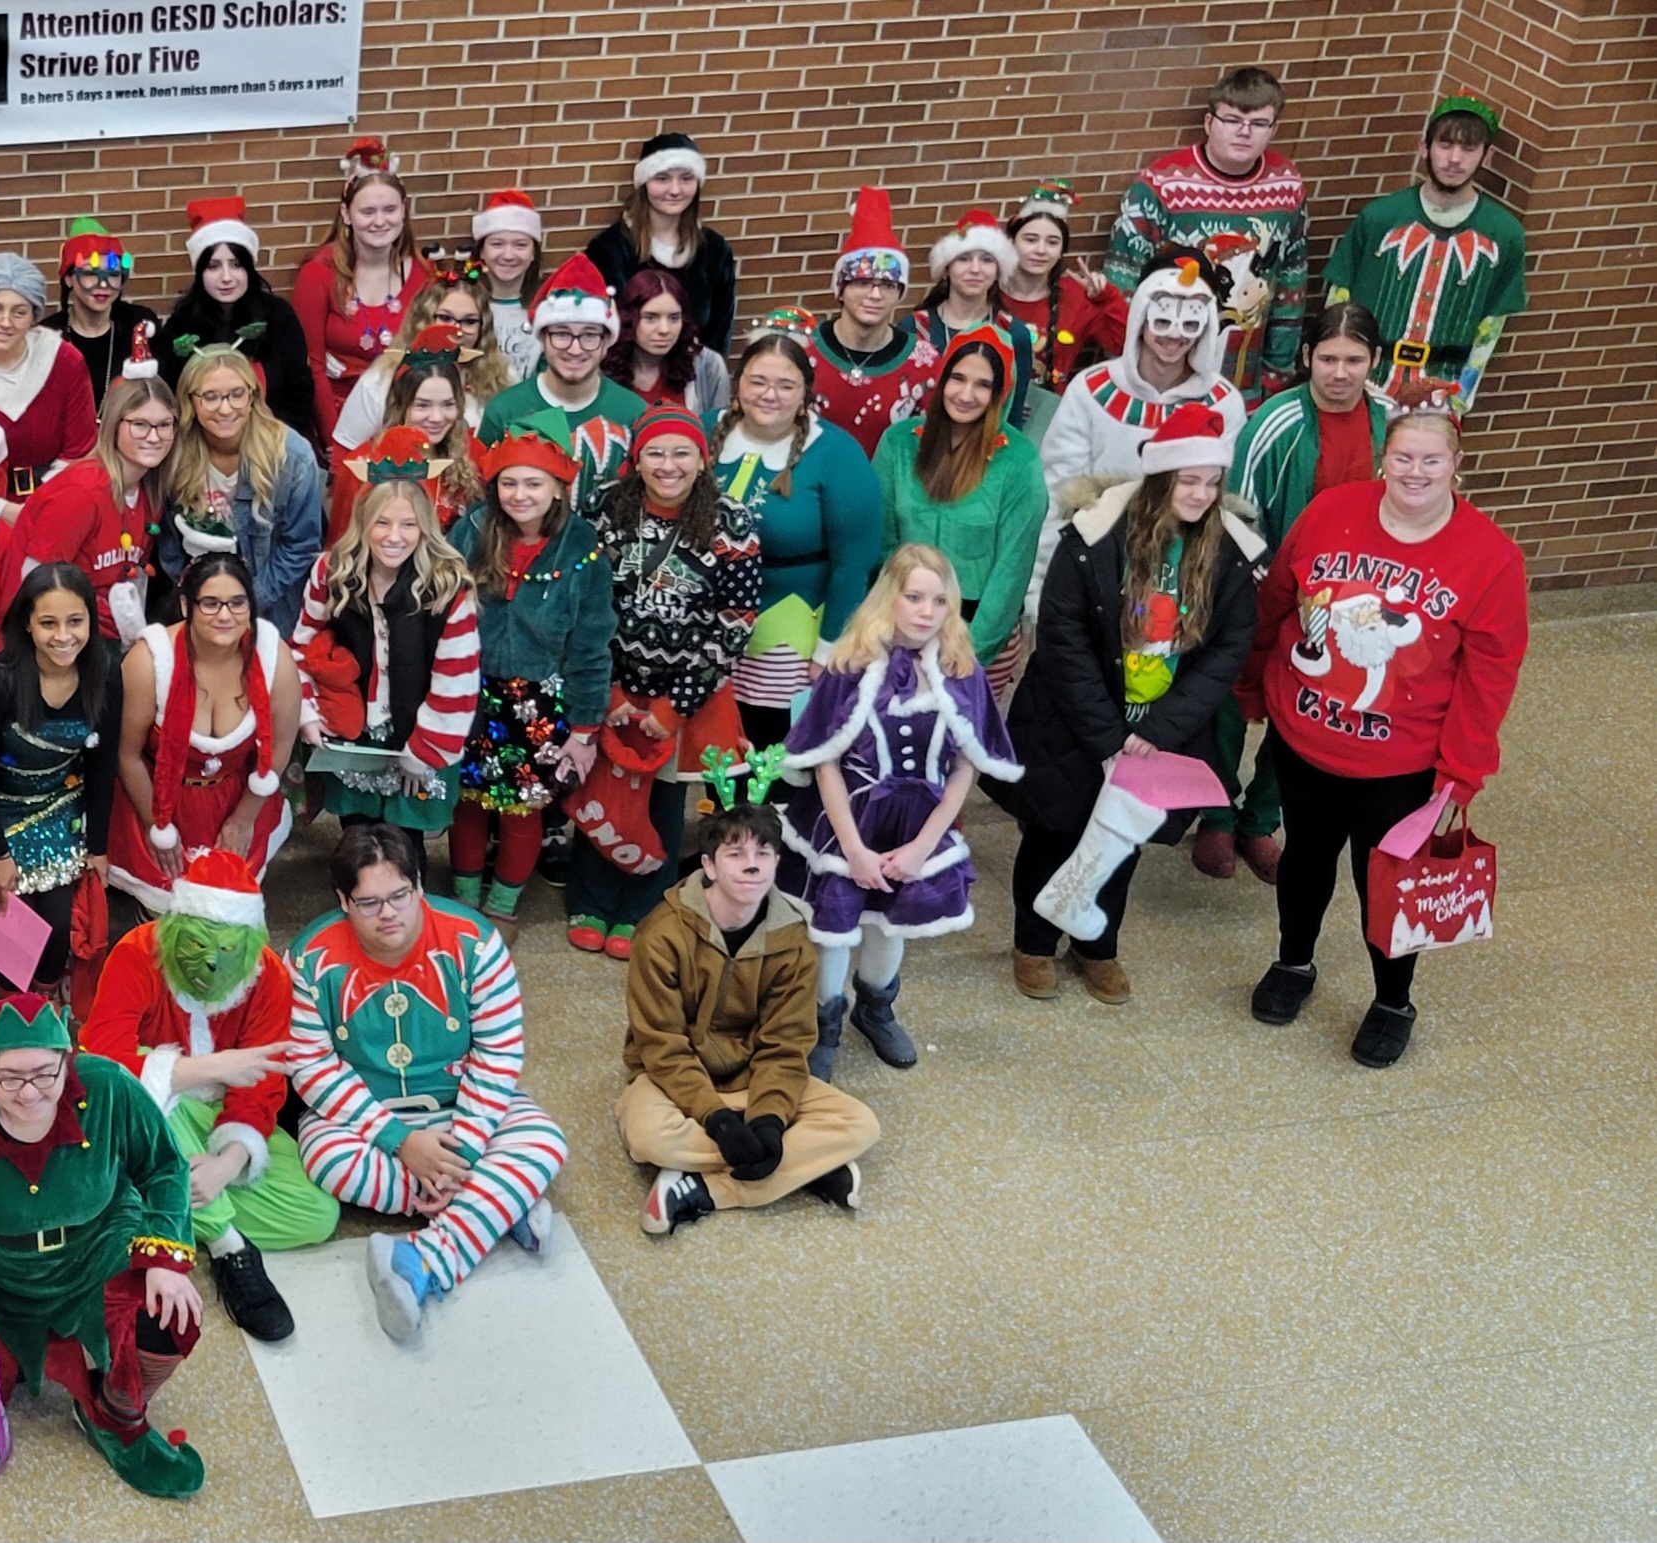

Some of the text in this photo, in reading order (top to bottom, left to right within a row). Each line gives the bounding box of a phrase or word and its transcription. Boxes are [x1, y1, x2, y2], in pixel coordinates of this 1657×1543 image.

[20, 0, 347, 41] Attention GESD Scholars:
[20, 46, 200, 79] Strive for Five
[21, 93, 35, 105] Be
[38, 91, 64, 103] here
[67, 90, 73, 101] 5
[76, 88, 103, 102] days
[106, 90, 112, 100] a
[150, 86, 178, 97] Don't
[180, 83, 207, 96] miss
[210, 84, 239, 95] more
[242, 81, 266, 93] than
[268, 80, 276, 92] 5
[278, 79, 304, 92] days
[306, 81, 313, 90] a
[316, 76, 344, 90] year!
[1308, 553, 1458, 620] SANTA'S
[1297, 687, 1390, 740] V.I.P.
[1416, 883, 1464, 914] Merry
[1435, 889, 1486, 923] Christmas
